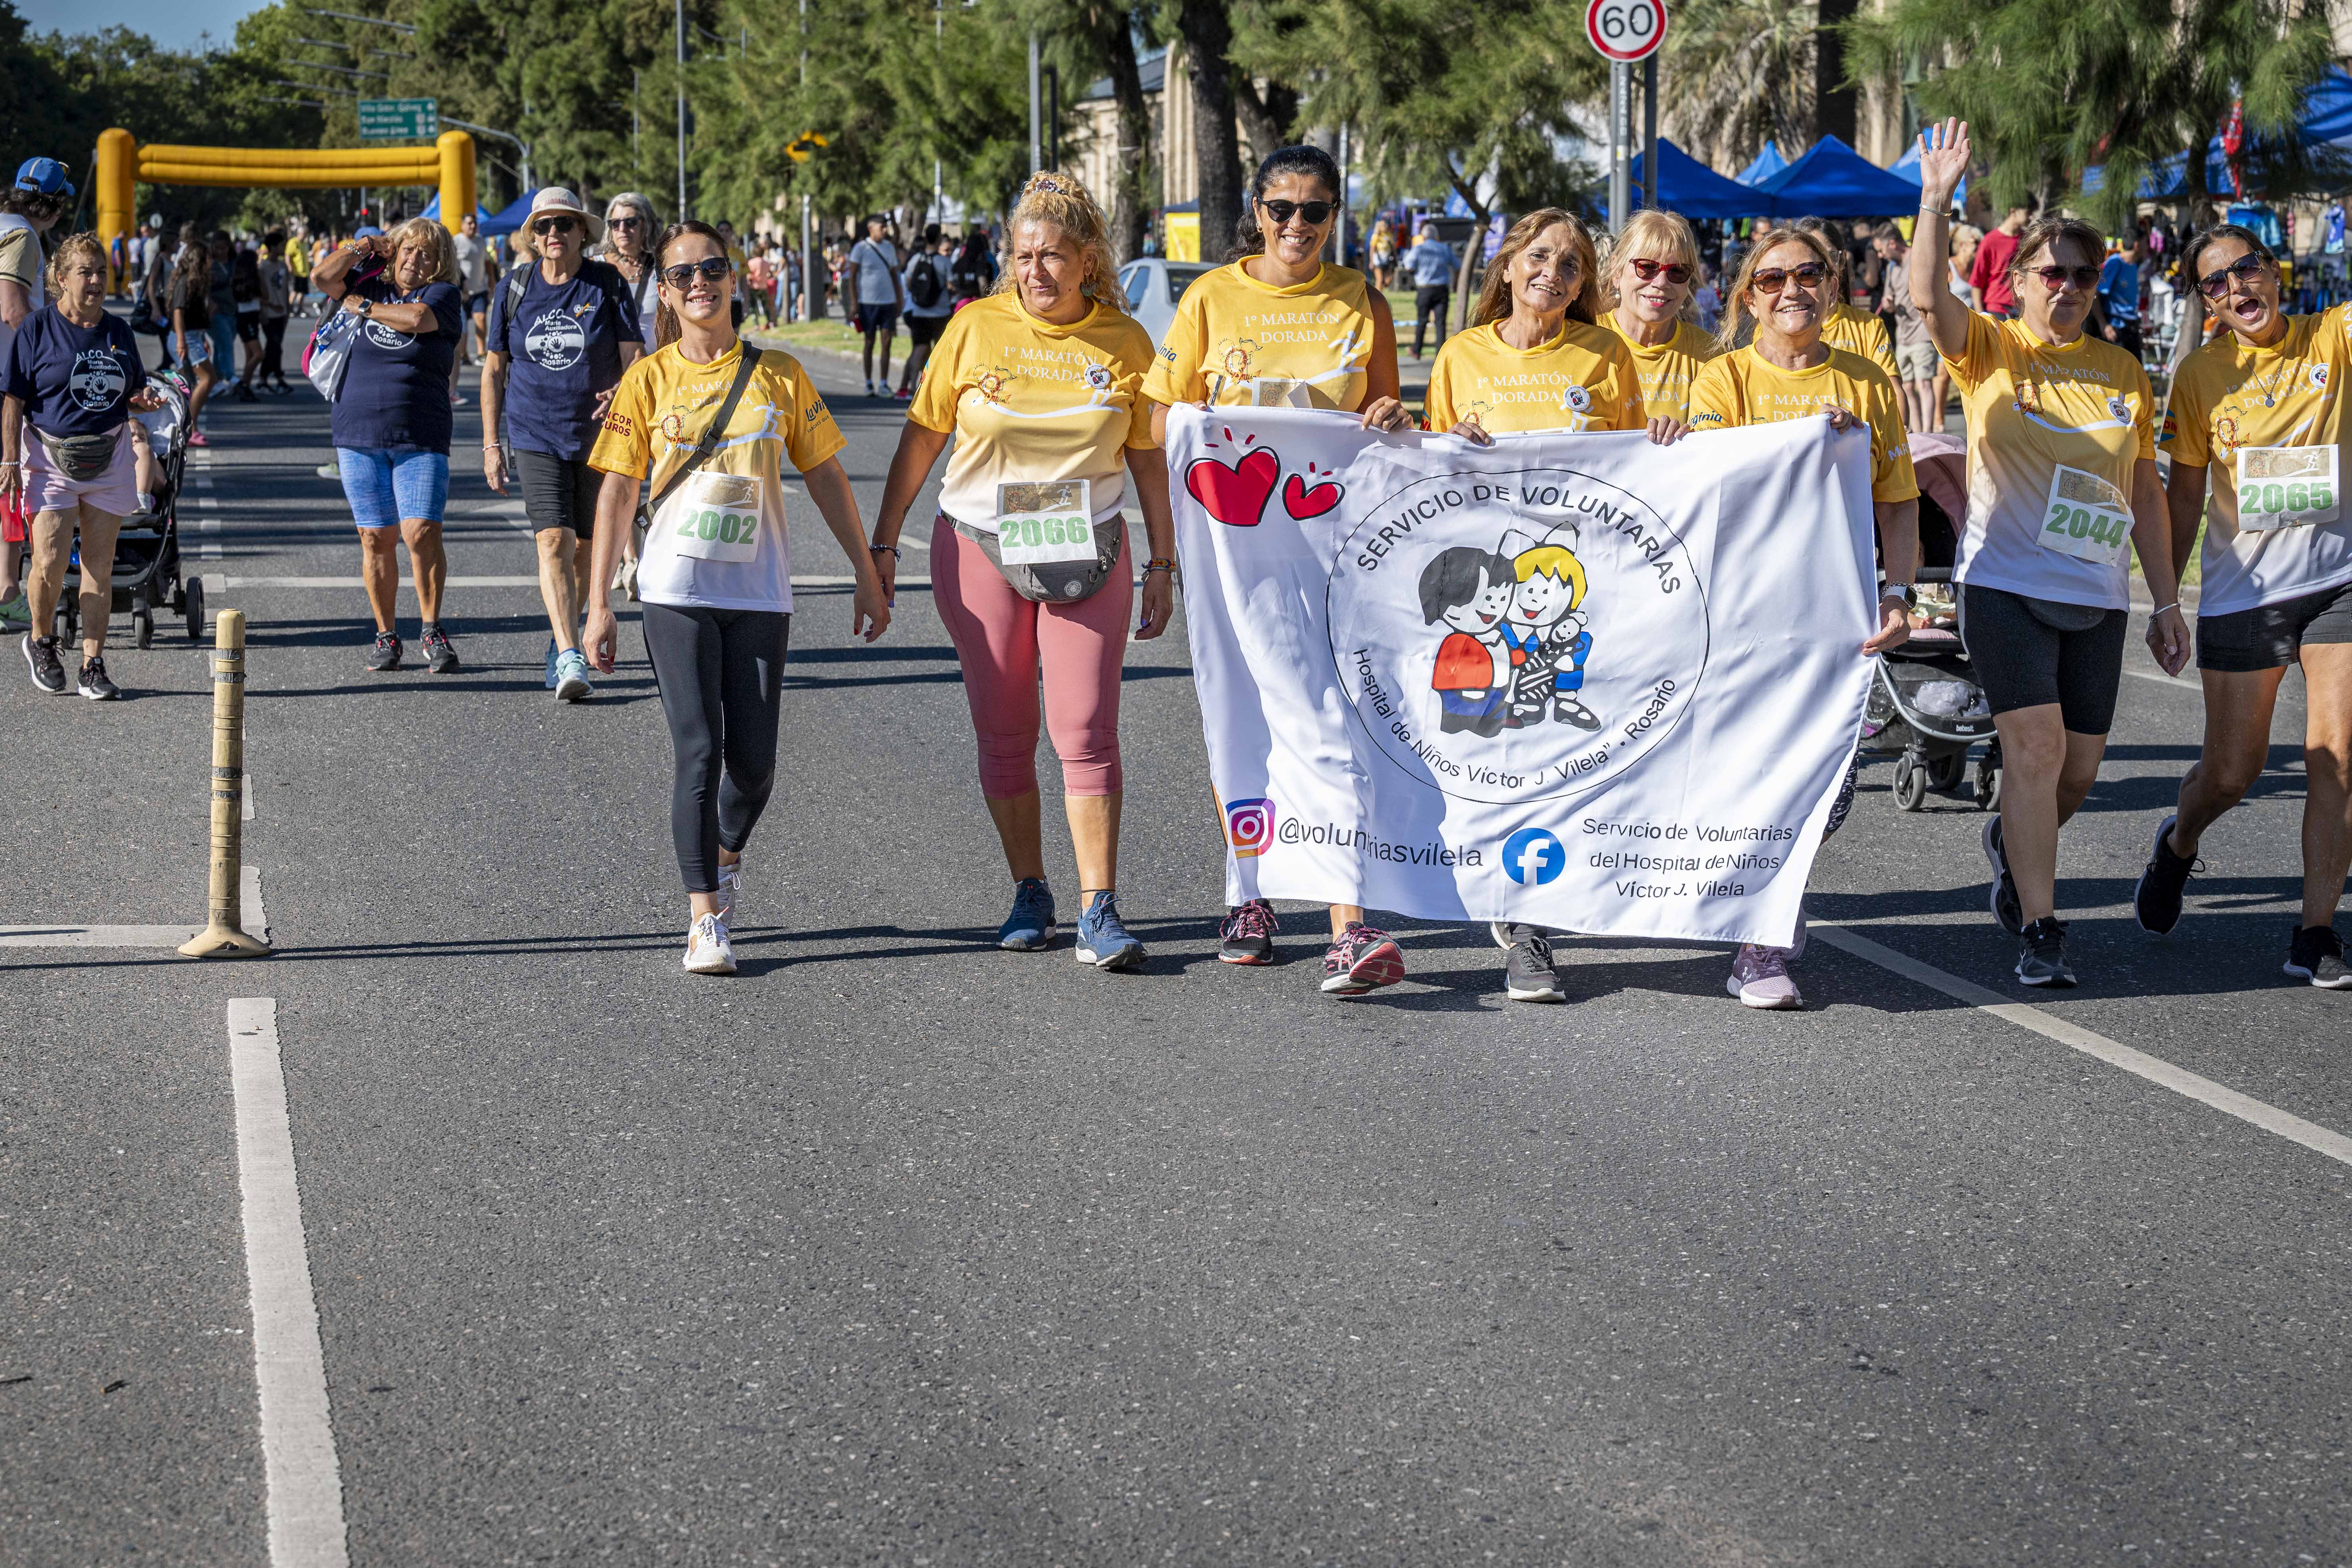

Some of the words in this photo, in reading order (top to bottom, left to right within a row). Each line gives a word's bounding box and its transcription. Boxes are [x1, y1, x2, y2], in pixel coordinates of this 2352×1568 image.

[1603, 4, 1653, 38] 60
[534, 309, 564, 326] ALCO
[1261, 310, 1340, 326] MARATÓN
[373, 334, 402, 346] Rosario
[1260, 330, 1329, 344] DORADA
[76, 350, 103, 362] ALCO
[1020, 347, 1097, 366] MARATÓN
[1016, 365, 1082, 382] DORADA
[1493, 371, 1574, 386] MARATÓN
[691, 380, 762, 394] MARAN
[691, 395, 753, 407] DORA
[1491, 391, 1561, 404] DORADA
[604, 421, 631, 436] UROS
[807, 421, 821, 433] SABORES
[2240, 482, 2333, 514] 2065
[676, 508, 757, 545] 2002
[1000, 517, 1089, 548] 2066
[2046, 504, 2127, 549] 2044
[1358, 490, 1464, 571] SERVICIO
[1473, 485, 1510, 501] DE
[1521, 485, 1681, 595] VOLUNTARIAS
[1353, 648, 1396, 720] Hospital
[1391, 721, 1411, 742] de
[1410, 739, 1460, 776] Niños
[1468, 765, 1525, 788] Víctor
[1535, 771, 1550, 785] J.
[1624, 678, 1676, 740] Rosario
[1582, 818, 1661, 840] Servicio
[1665, 824, 1688, 839] de
[1696, 824, 1793, 841] Voluntarias
[1589, 854, 1619, 868] del
[1624, 853, 1700, 875] Hospital
[1705, 855, 1725, 869] de
[1726, 854, 1779, 869] Niños
[1616, 881, 1671, 898] Víctor
[1673, 883, 1688, 897] J.
[1697, 881, 1745, 897] Vilela
